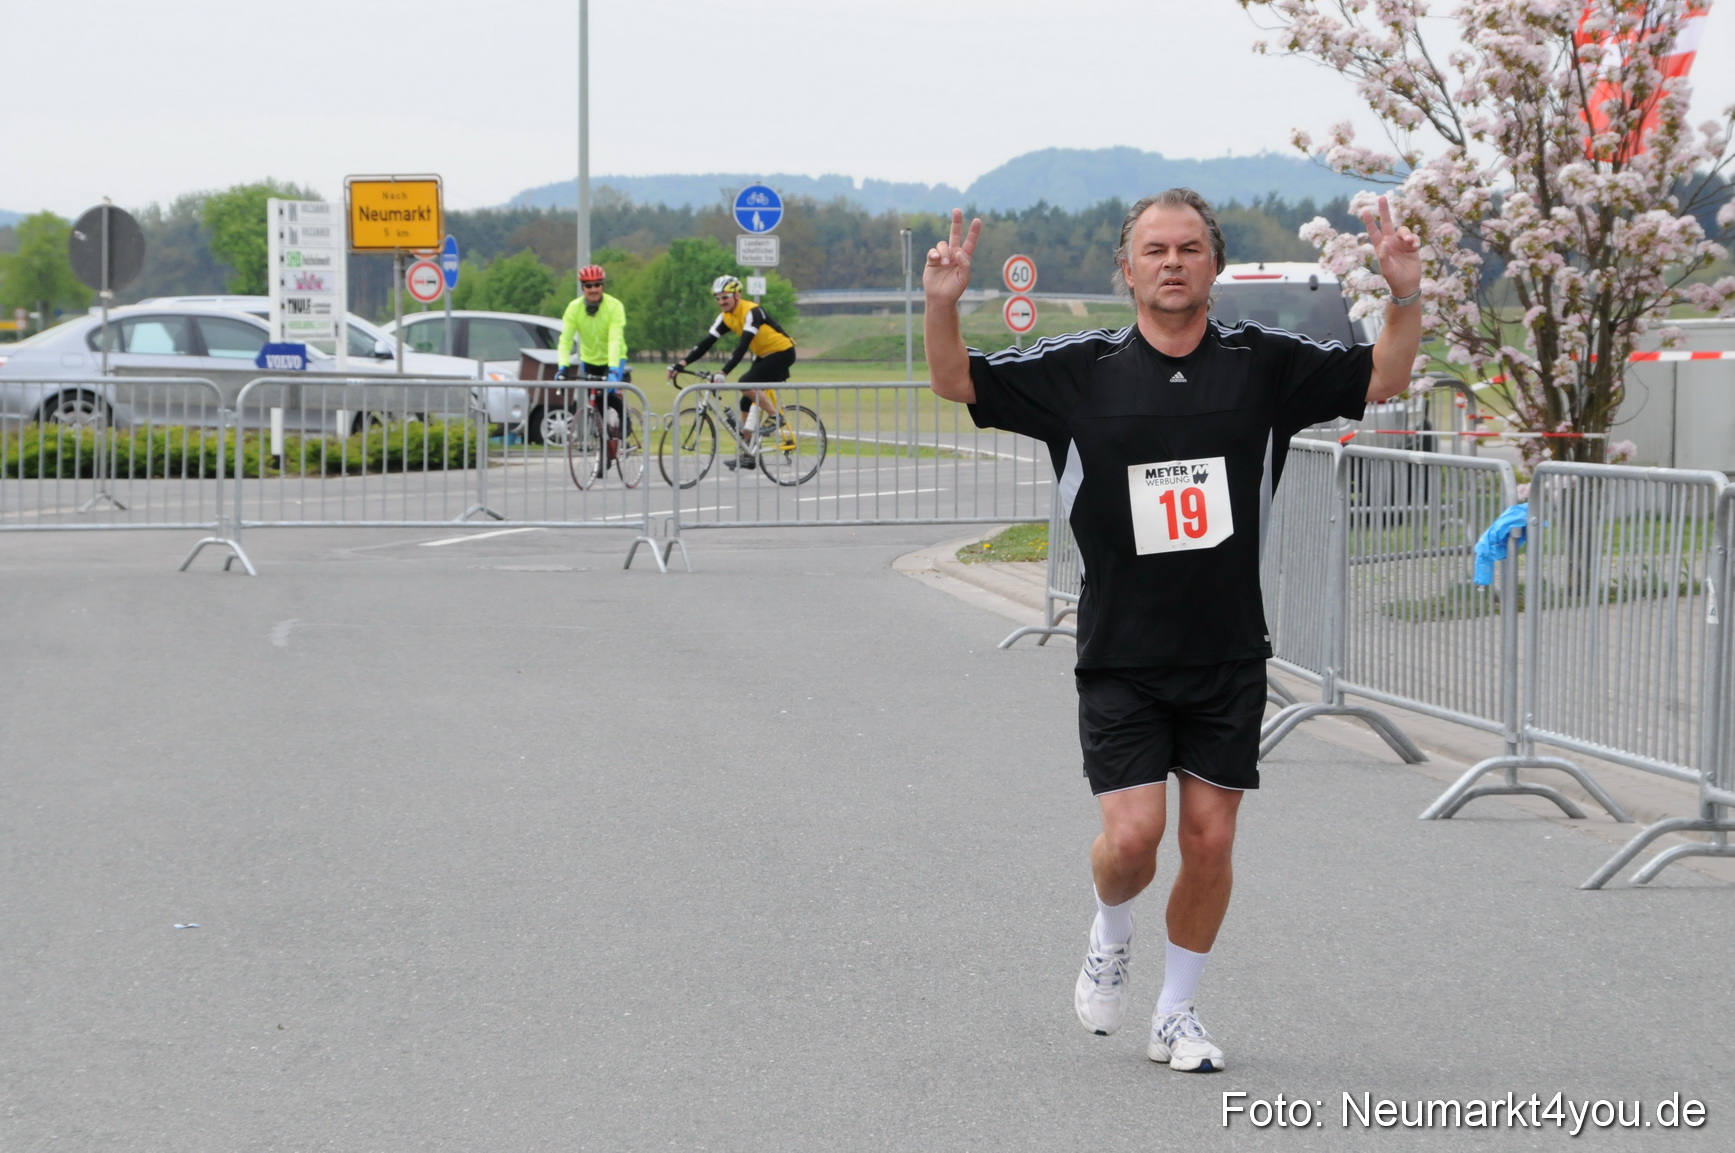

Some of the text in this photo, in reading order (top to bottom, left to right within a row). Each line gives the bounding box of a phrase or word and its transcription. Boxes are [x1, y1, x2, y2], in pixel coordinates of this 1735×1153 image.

[382, 192, 408, 200] Nach
[359, 205, 432, 221] Neumarkt
[384, 228, 410, 237] 5 km
[1012, 266, 1029, 282] 60
[265, 354, 303, 369] VOLVO
[1145, 466, 1188, 479] MEYER
[1145, 476, 1190, 487] WERBUNG
[1159, 487, 1208, 540] 19
